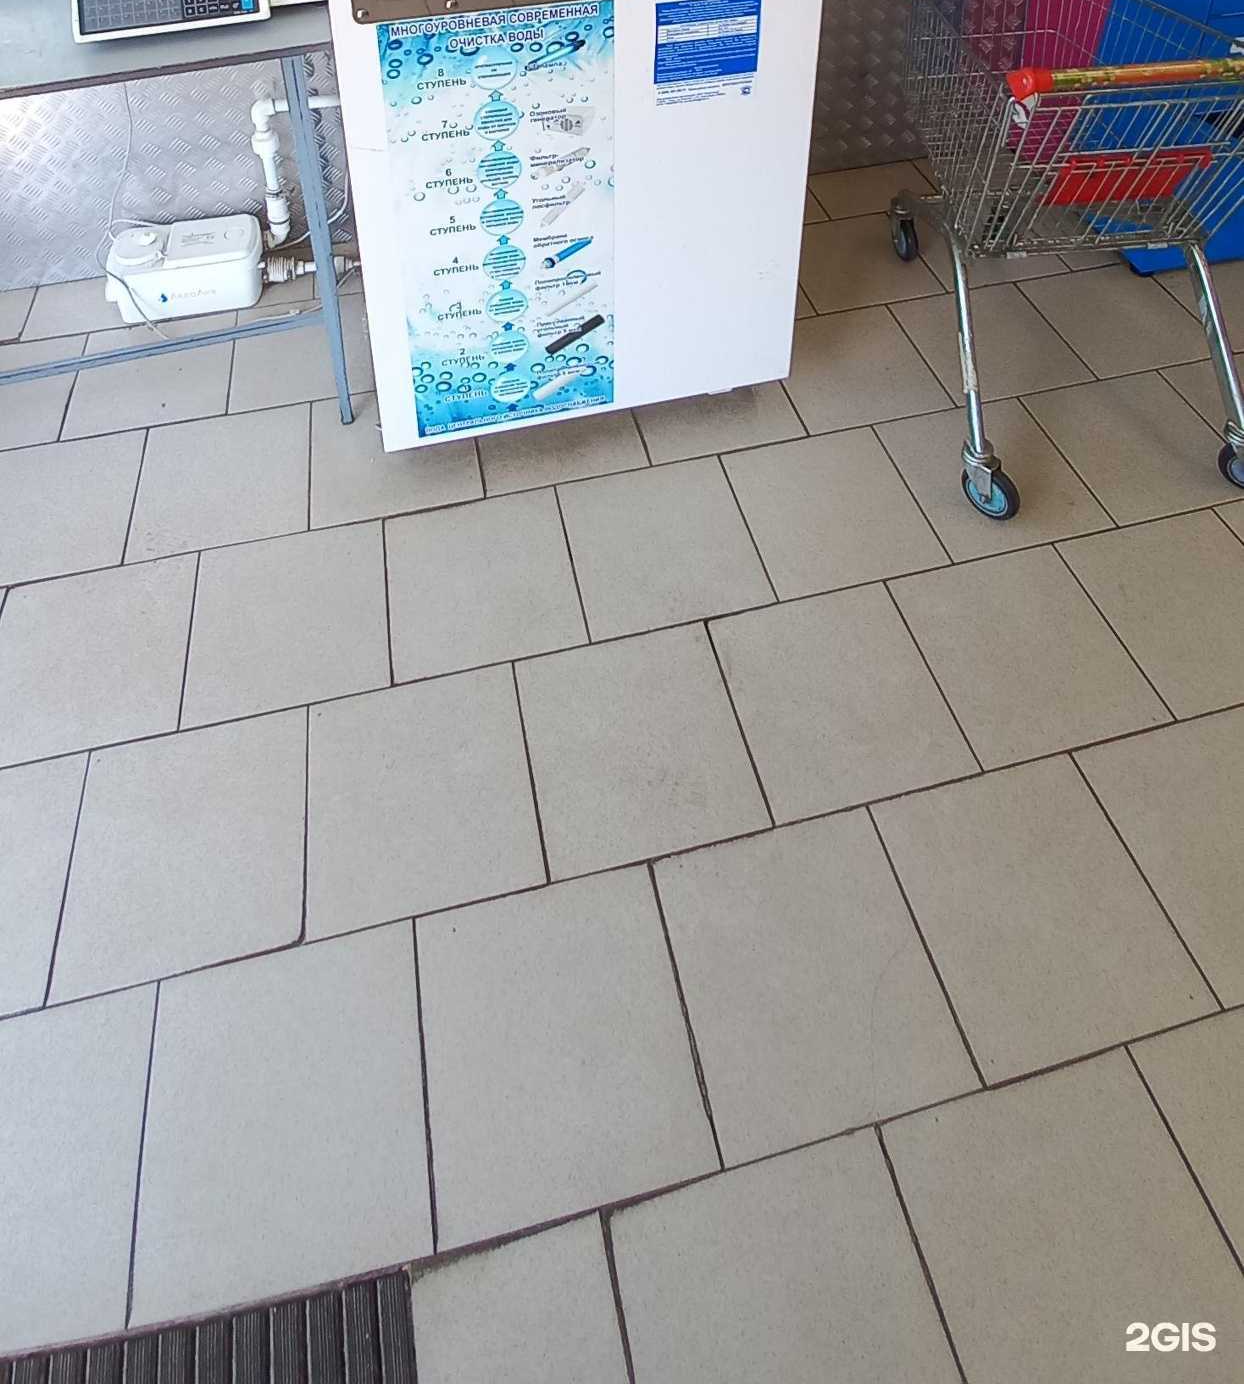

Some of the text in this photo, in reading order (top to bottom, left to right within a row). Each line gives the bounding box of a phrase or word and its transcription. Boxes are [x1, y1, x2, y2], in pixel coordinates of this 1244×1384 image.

[391, 4, 599, 37] МНОГОУРОВНЕВАЯ СОВРЕМЕННАЯ
[449, 29, 544, 49] ОЧИСТКА ВОДЫ
[438, 68, 444, 77] 8
[417, 78, 466, 90] СТУПЕНЬ
[442, 120, 448, 129] 7
[421, 129, 470, 141] СТУПЕНЬ
[445, 168, 452, 177] 6
[426, 177, 473, 189] СТУПЕНЬ
[449, 216, 456, 224] 5
[430, 224, 476, 236] СТУПЕНЬ
[433, 264, 479, 277] СТУПЕНЬ
[437, 308, 482, 321] СТУПЕНЬ
